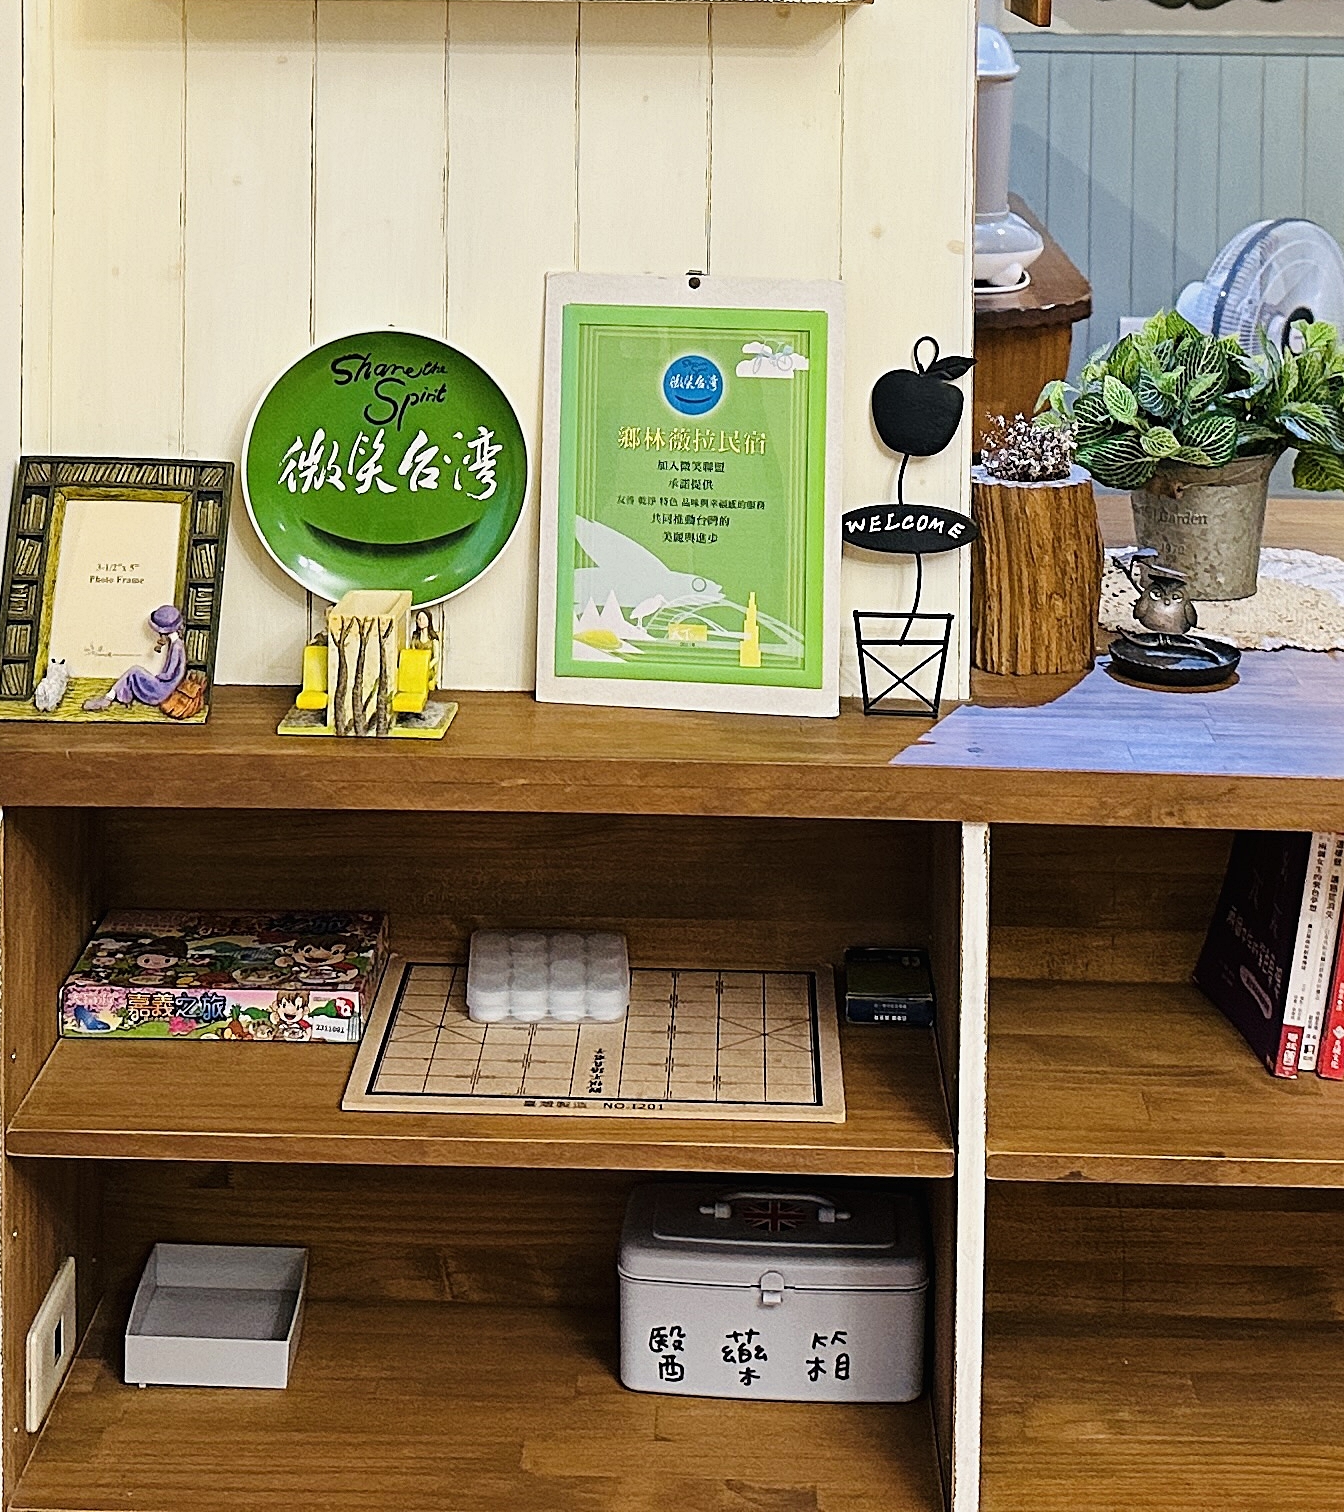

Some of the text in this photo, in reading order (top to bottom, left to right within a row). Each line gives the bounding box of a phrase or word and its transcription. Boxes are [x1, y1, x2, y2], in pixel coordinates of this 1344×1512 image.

[363, 377, 447, 431] Spirit
[845, 513, 965, 539] WELCOME
[126, 992, 227, 1023] 嘉義之旅
